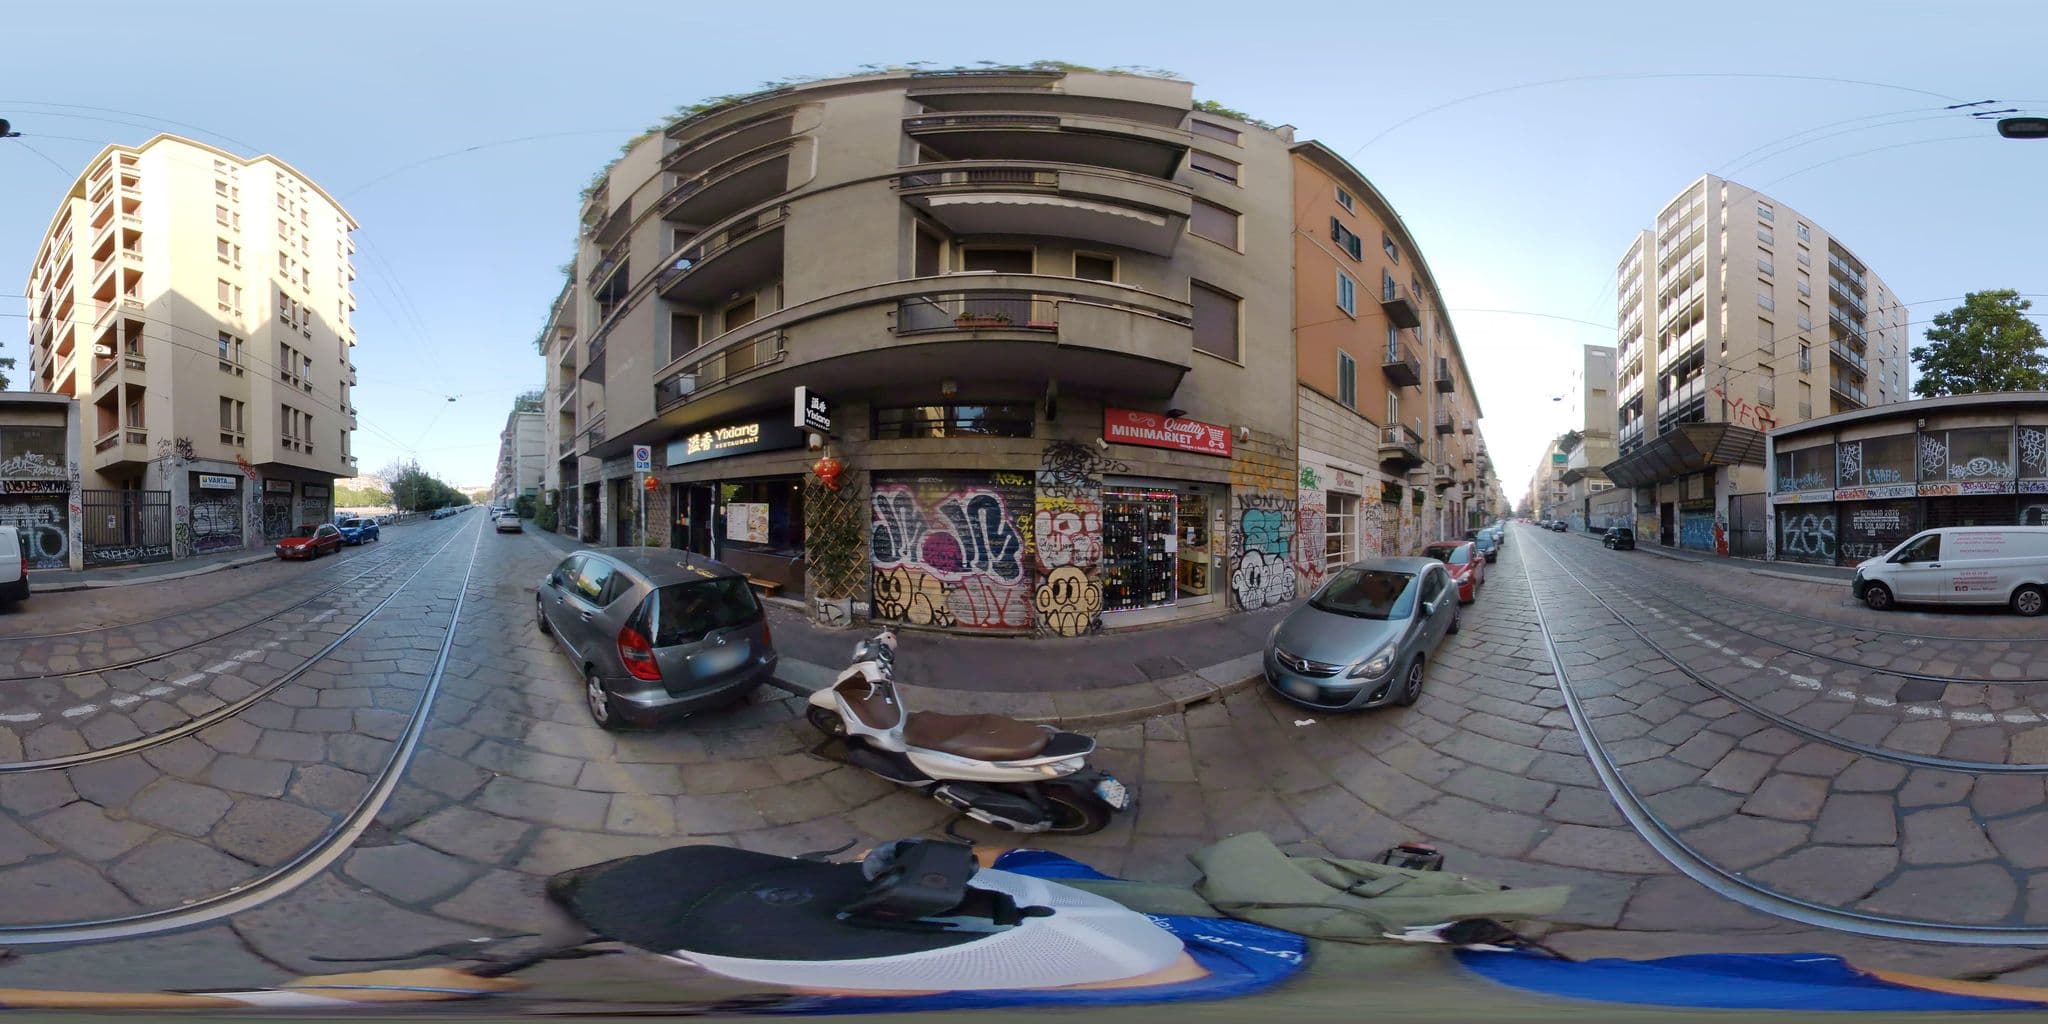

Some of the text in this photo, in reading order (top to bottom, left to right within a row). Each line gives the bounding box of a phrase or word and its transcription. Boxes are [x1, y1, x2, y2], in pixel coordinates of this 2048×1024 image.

[806, 408, 830, 427] Yixiang
[714, 424, 759, 440] Yixiang
[1112, 424, 1192, 444] MINIMARKET
[1164, 417, 1205, 440] Quality
[715, 436, 759, 449] RESTAURANT
[208, 476, 228, 484] VARTA
